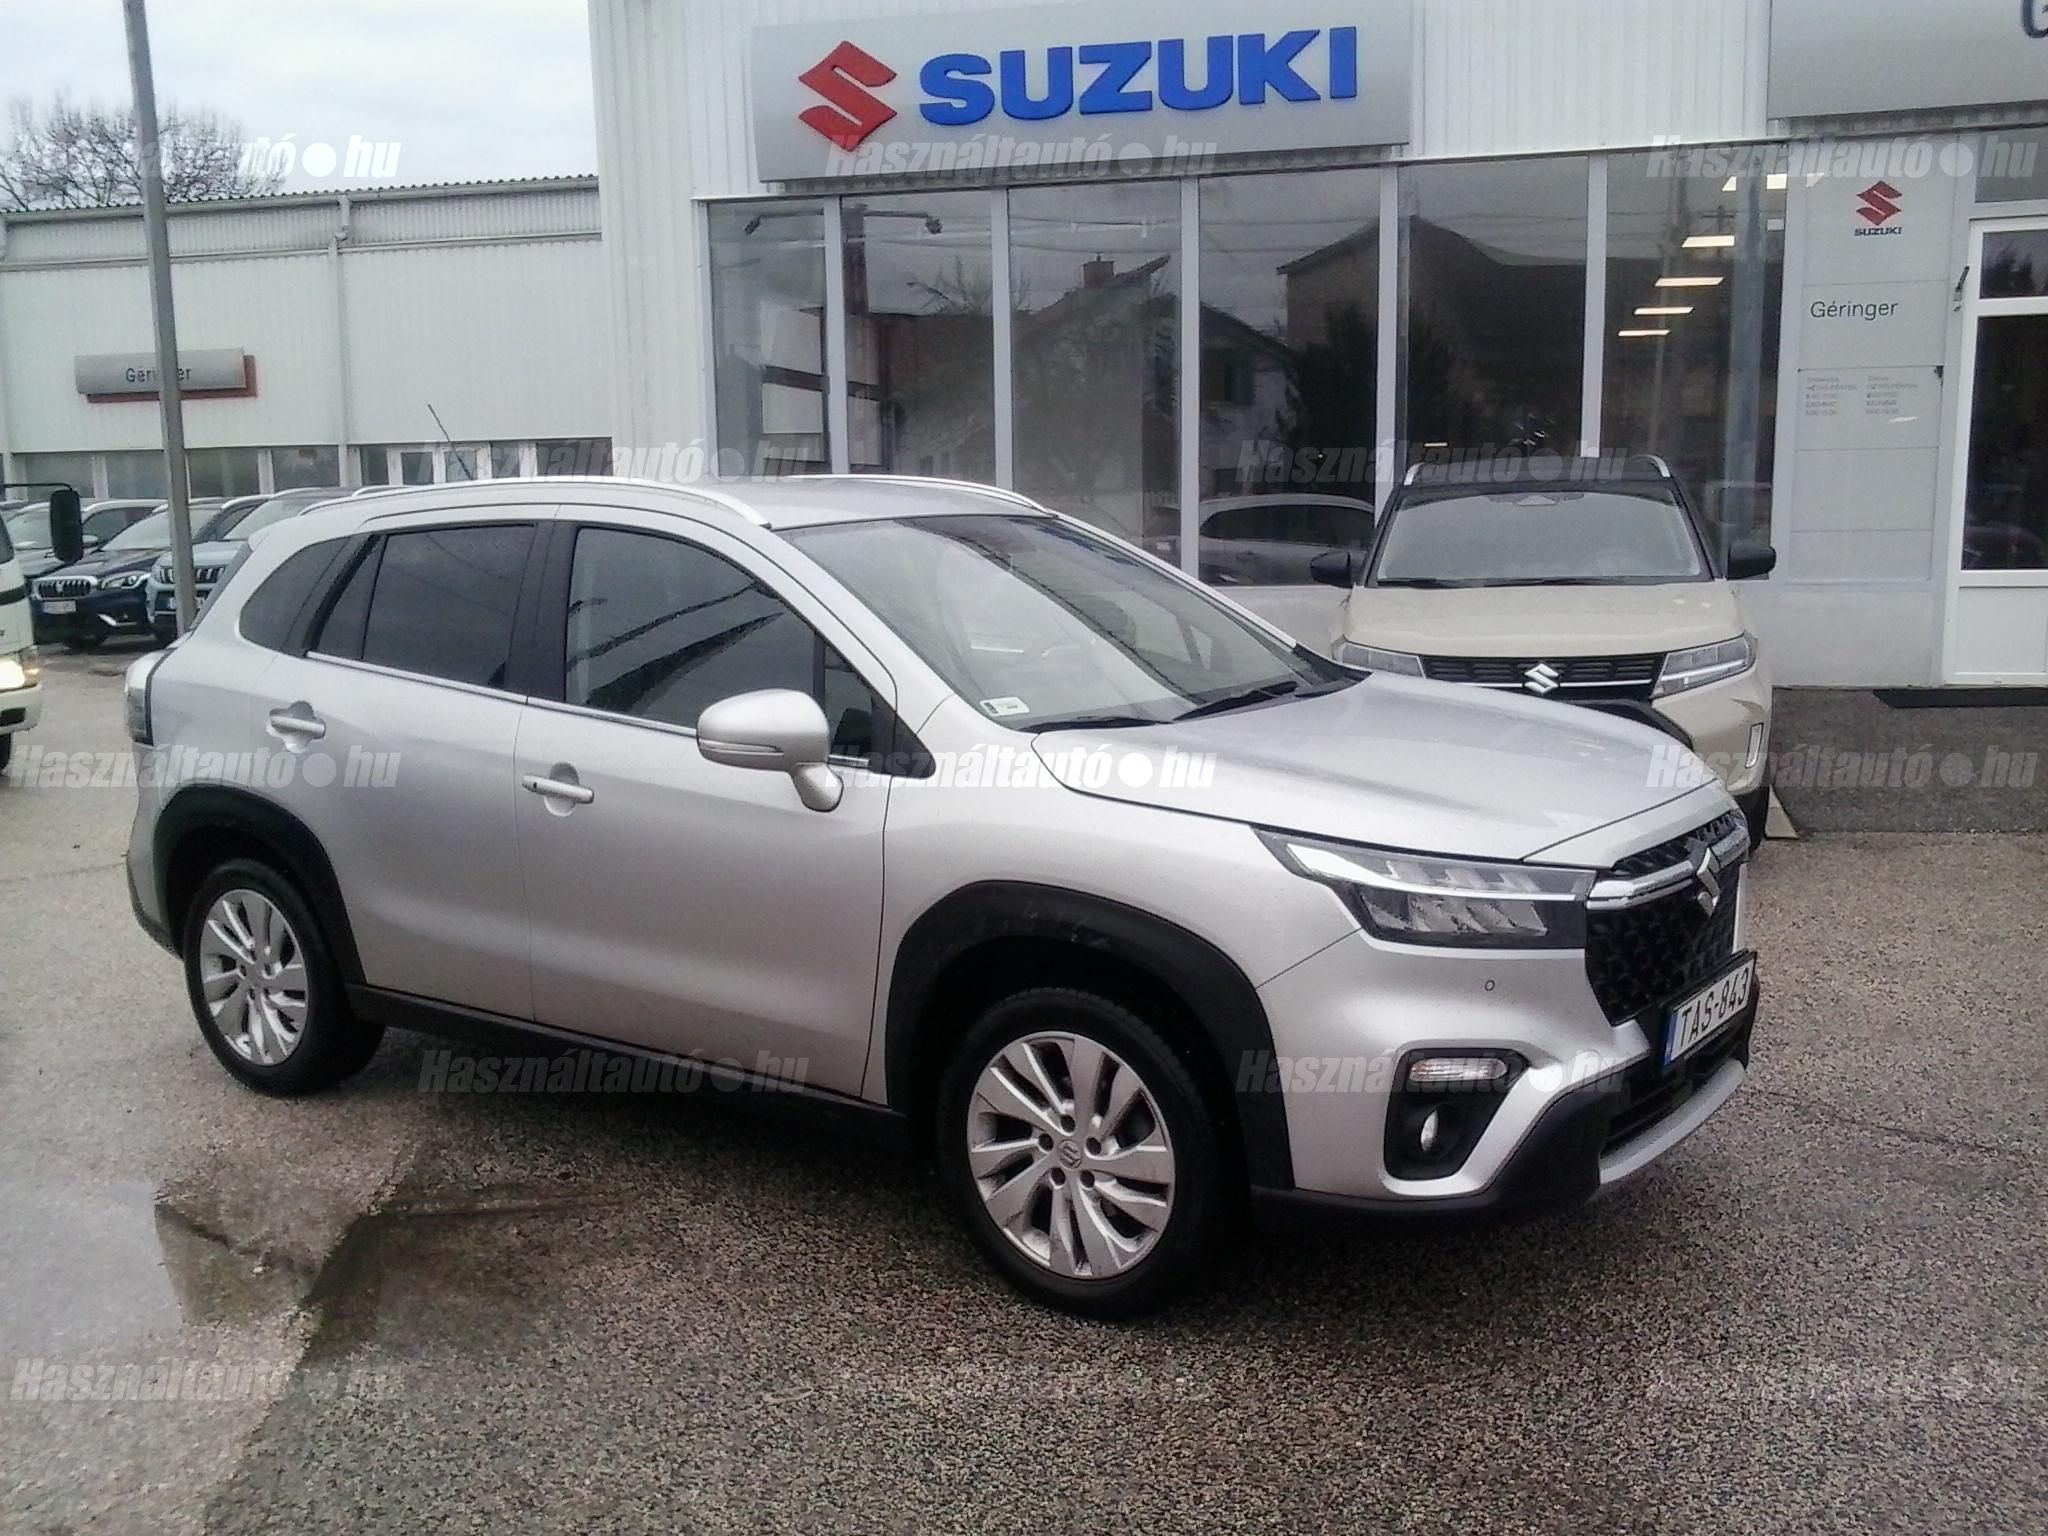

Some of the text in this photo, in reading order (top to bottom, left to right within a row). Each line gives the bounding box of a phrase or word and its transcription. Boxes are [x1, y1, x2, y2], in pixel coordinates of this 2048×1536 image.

[919, 26, 1358, 126] SUZUKI
[1854, 226, 1902, 237] SUZUKI
[1810, 300, 1899, 321] Géringer
[1681, 967, 1749, 1048] TAS-843
